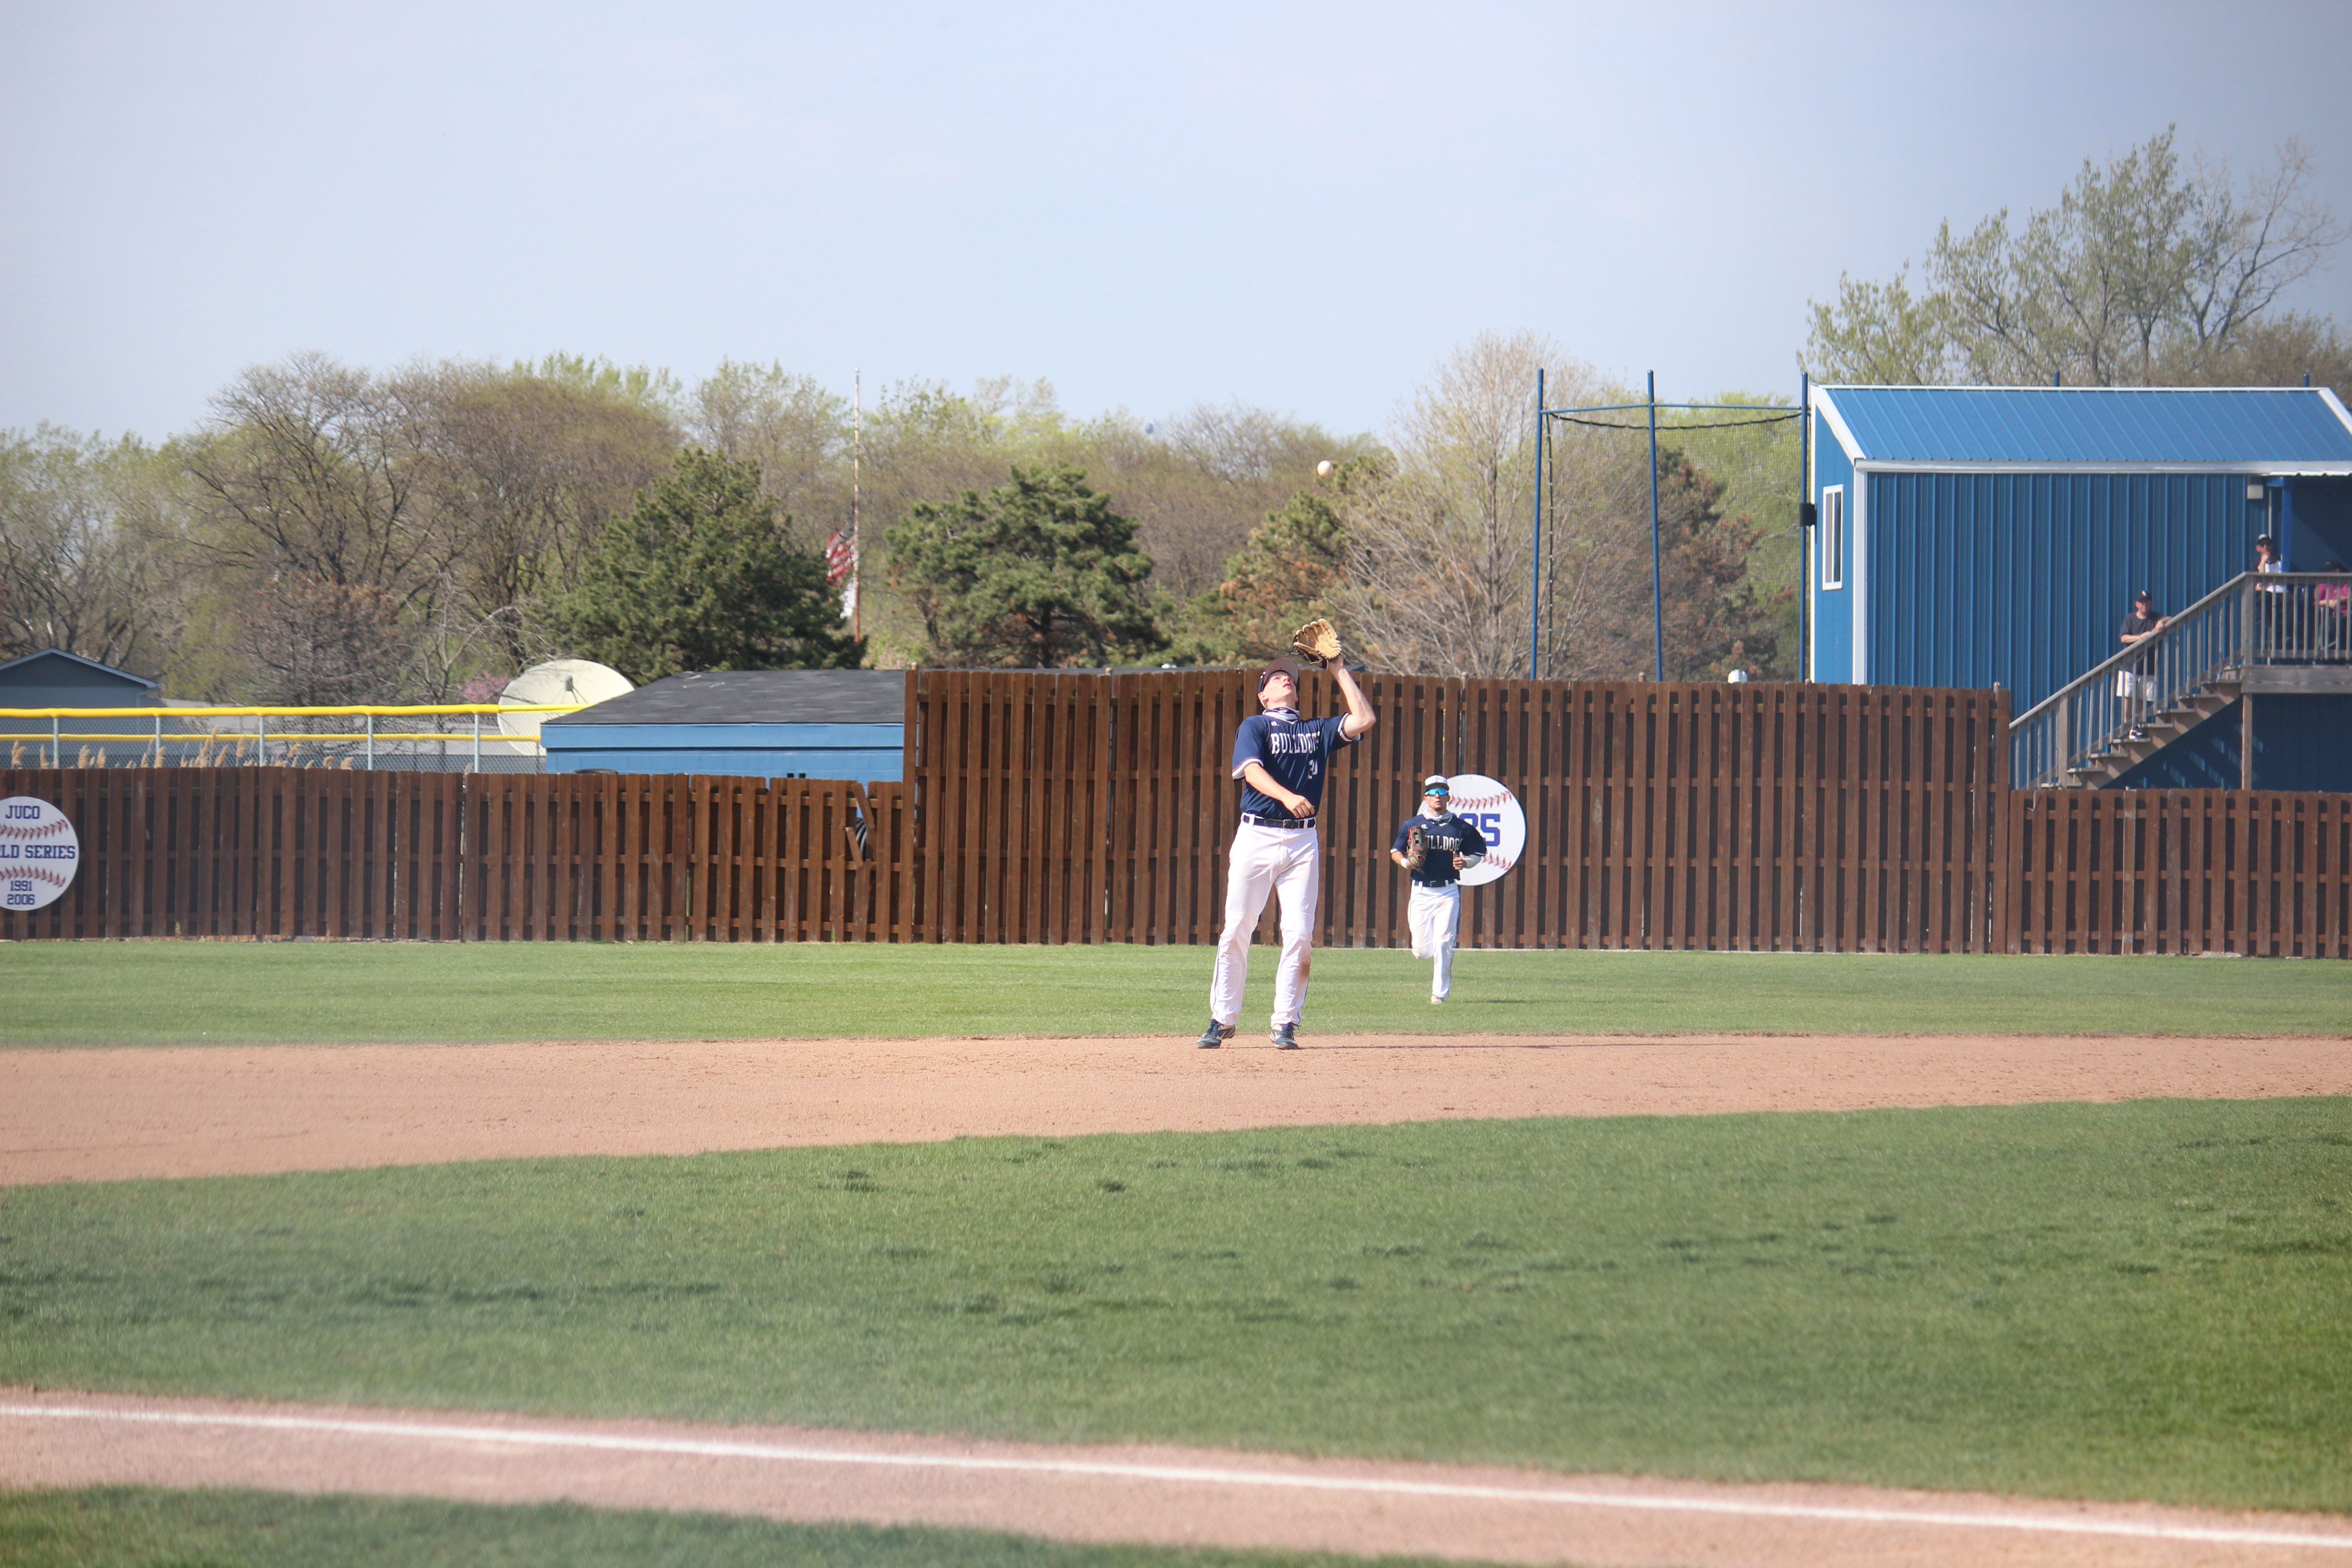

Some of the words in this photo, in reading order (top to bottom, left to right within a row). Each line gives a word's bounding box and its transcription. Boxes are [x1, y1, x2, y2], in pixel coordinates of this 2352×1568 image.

[5, 805, 40, 819] JUCO
[0, 845, 19, 858] LD
[25, 845, 75, 859] SERIES
[10, 880, 32, 891] 1991
[7, 894, 34, 905] 2006
